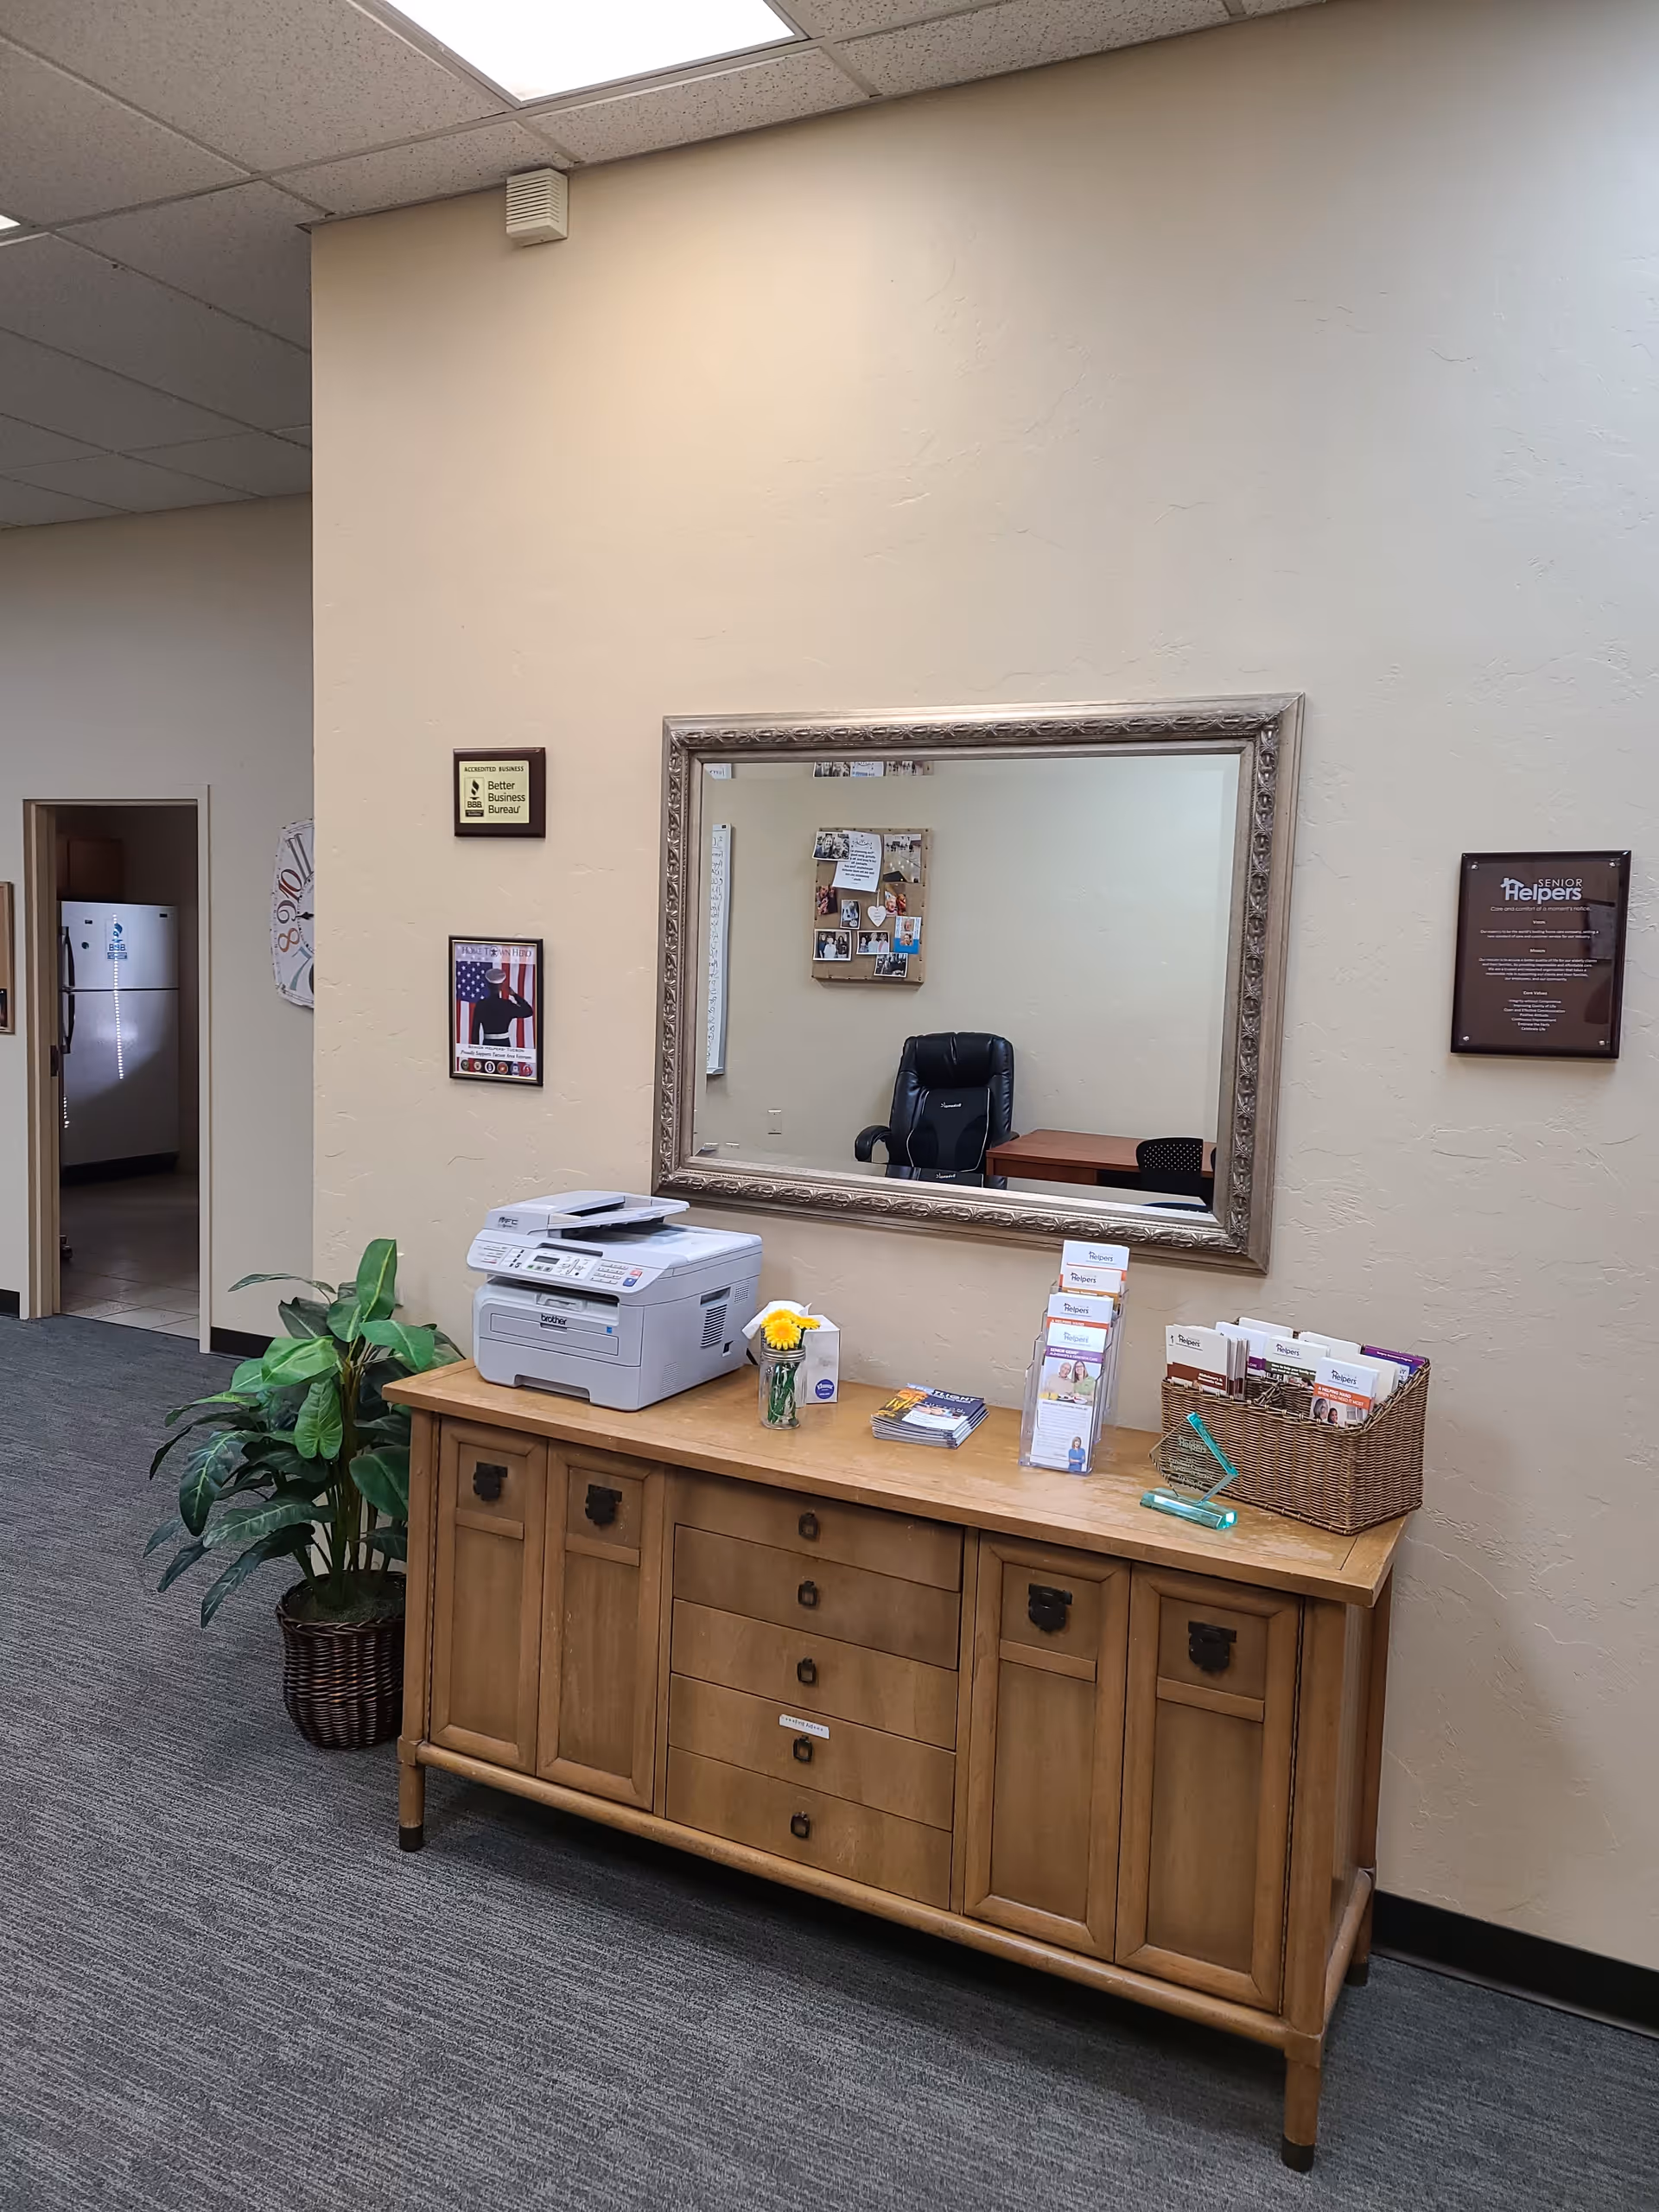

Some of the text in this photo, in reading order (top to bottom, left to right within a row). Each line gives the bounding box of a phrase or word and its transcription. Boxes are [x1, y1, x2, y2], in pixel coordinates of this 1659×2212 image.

[487, 780, 515, 790] Better
[488, 791, 525, 802] Business
[488, 804, 520, 813] Bureau
[1538, 878, 1583, 887] SENIOR
[1501, 878, 1583, 905] Helpers
[276, 899, 296, 925] 9
[277, 927, 301, 953] 8
[290, 946, 312, 991] 7
[1089, 1251, 1114, 1262] Helpers
[1071, 1272, 1096, 1283] Helpers
[1064, 1302, 1089, 1313] Helpers
[541, 1313, 567, 1325] brother
[1064, 1332, 1089, 1344] Helpers
[1178, 1334, 1201, 1347] Helpers
[1276, 1344, 1300, 1356] Helpers
[1332, 1370, 1357, 1385] Helpers
